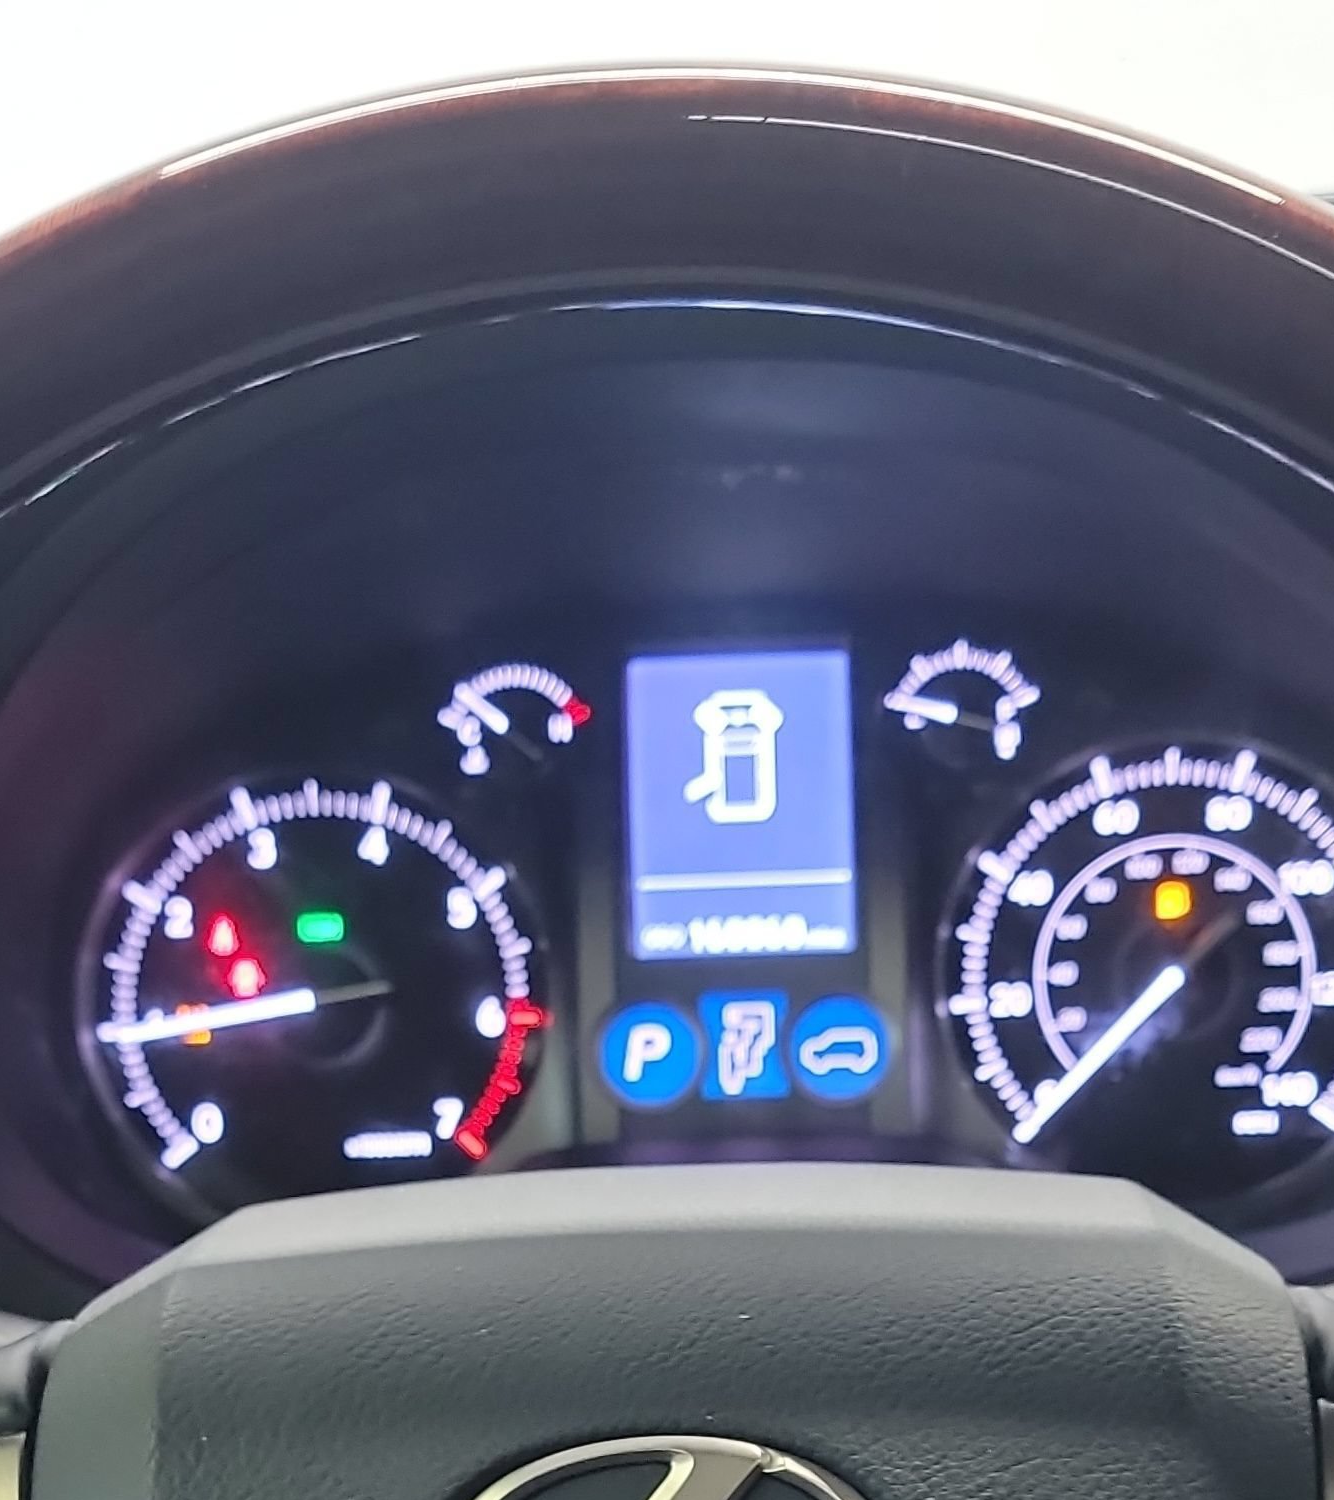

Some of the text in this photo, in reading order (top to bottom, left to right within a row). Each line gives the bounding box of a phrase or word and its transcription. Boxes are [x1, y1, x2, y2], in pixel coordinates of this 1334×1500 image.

[247, 827, 278, 870] 3
[357, 824, 391, 867] 4
[163, 895, 195, 940] 2
[189, 1101, 225, 1145] 0
[432, 1097, 464, 1141] 7
